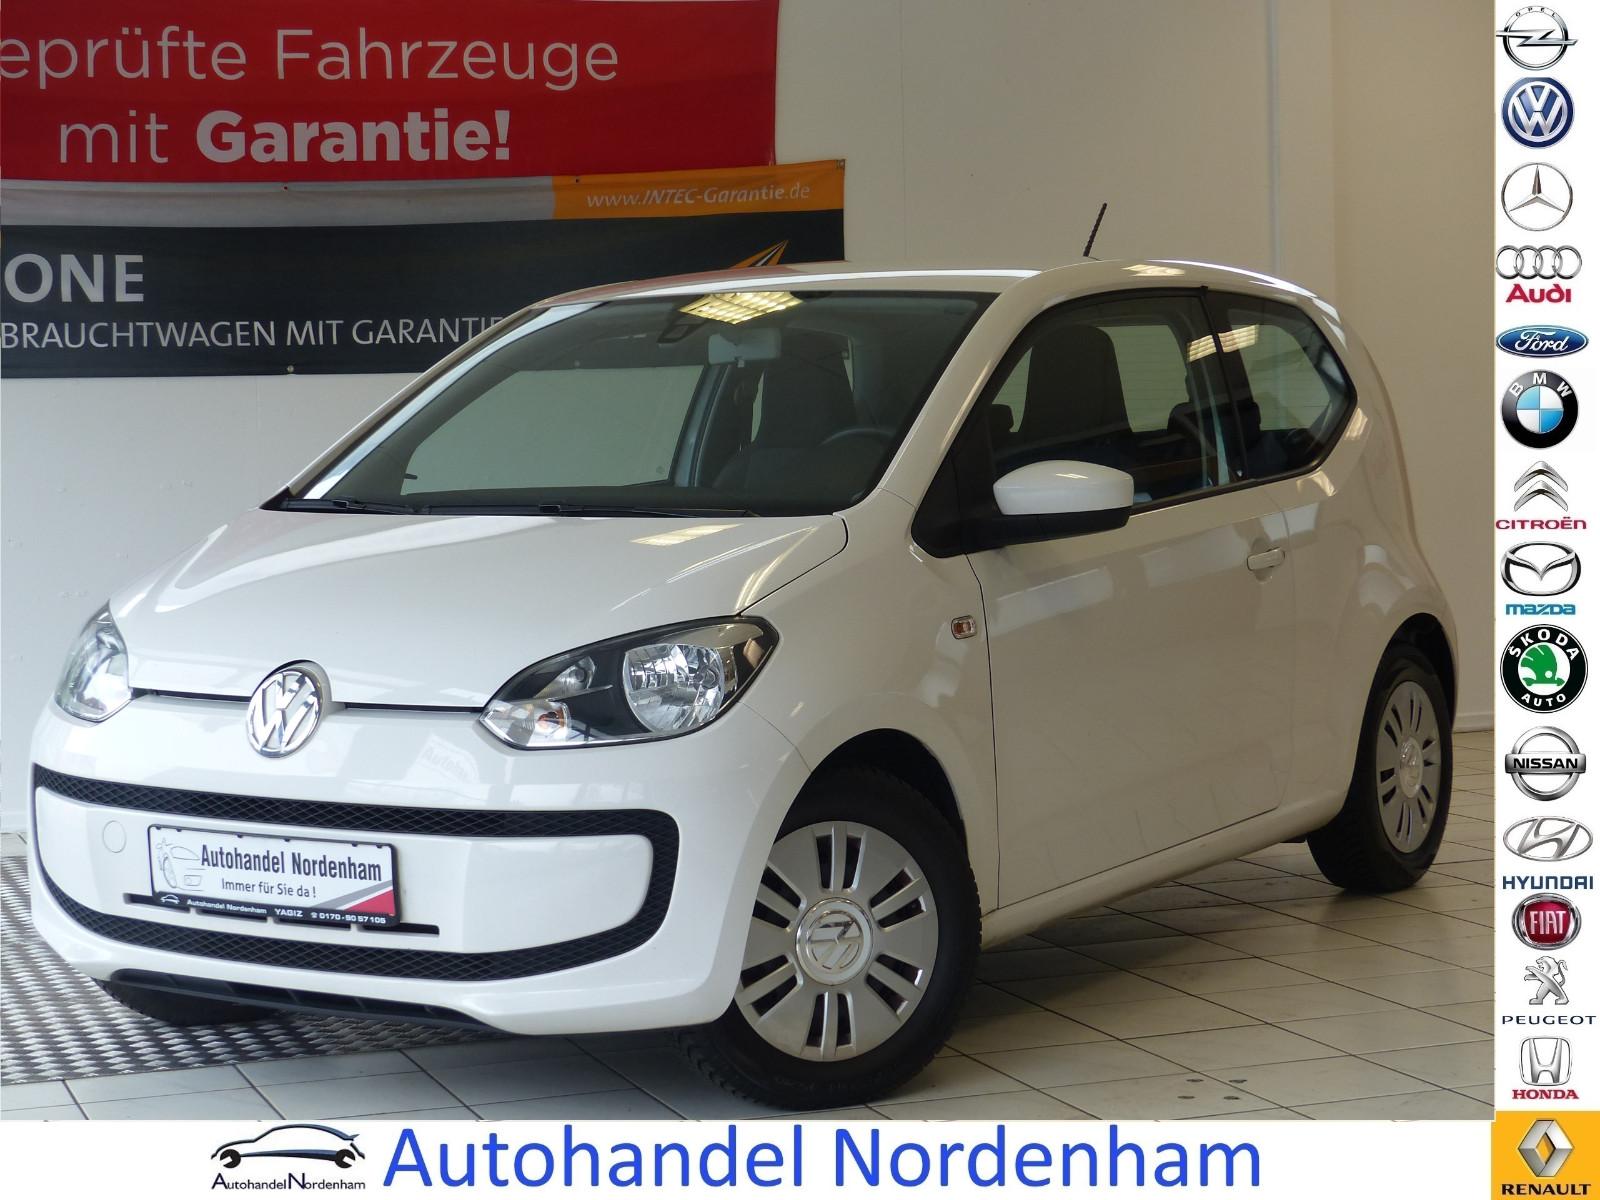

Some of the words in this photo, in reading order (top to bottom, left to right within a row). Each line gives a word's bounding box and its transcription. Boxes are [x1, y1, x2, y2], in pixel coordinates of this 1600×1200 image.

[276, 26, 618, 91] Fahrzeuge
[59, 109, 169, 163] mit
[196, 107, 511, 163] Garantie!
[586, 182, 811, 208] www.INTEC-Garantie.de
[4, 253, 144, 303] ONE
[0, 320, 276, 349] BRAUCHTWAGEN
[286, 319, 344, 346] MIT
[201, 844, 285, 873] Autohandel
[292, 852, 382, 881] Nordenham
[221, 878, 255, 893] Immer
[258, 881, 274, 895] für
[277, 883, 294, 896] Sie
[186, 899, 225, 910] Autohandel
[226, 903, 267, 914] Nordenham
[274, 908, 303, 917] YAGIZ
